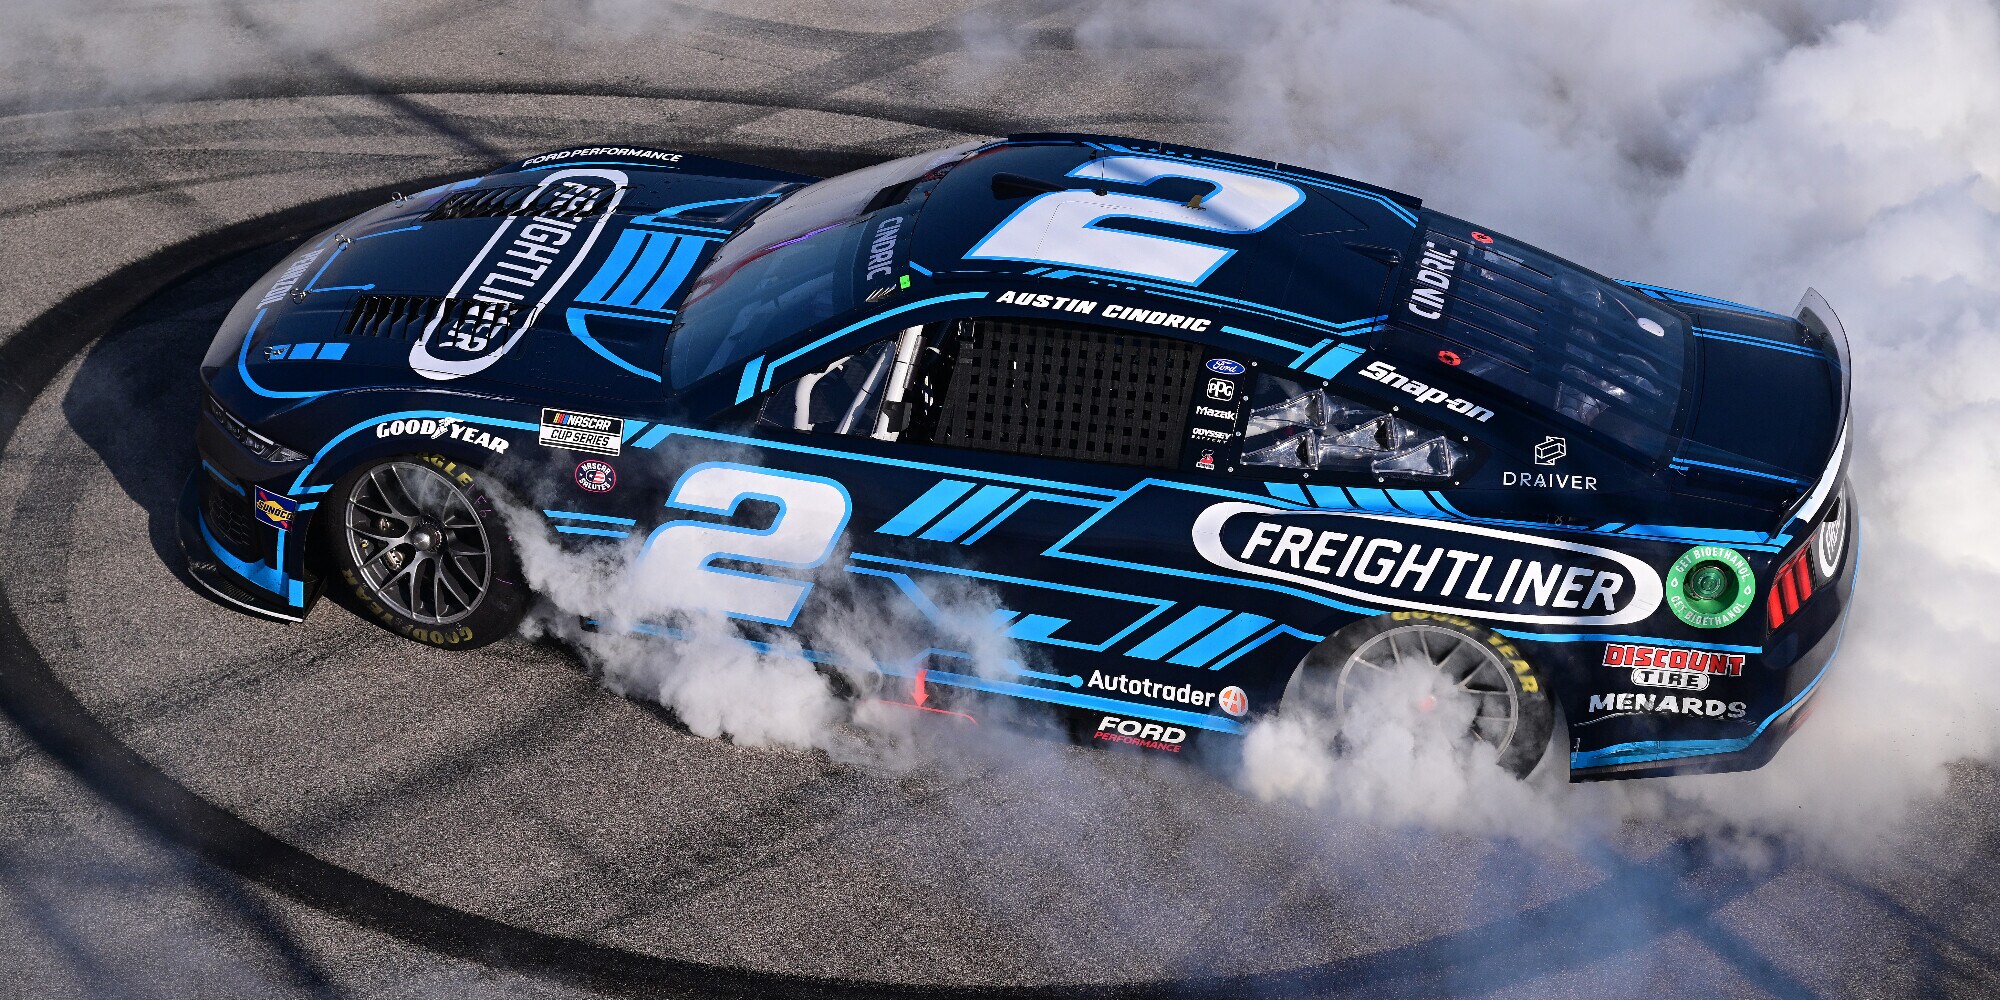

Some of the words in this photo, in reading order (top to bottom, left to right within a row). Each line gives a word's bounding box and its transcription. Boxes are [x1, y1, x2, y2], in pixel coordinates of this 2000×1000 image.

[522, 151, 571, 168] FORD
[571, 148, 683, 162] PERFORMANCE
[962, 154, 1307, 286] 2
[867, 217, 904, 281] CINDRIC
[996, 290, 1098, 315] AUSTIN
[1101, 304, 1212, 332] CINDRIC
[1209, 381, 1233, 397] PPG
[1358, 361, 1495, 423] Snap-on
[567, 415, 611, 431] NASCAR
[1196, 405, 1236, 421] Mazak
[551, 429, 577, 442] CUP
[578, 433, 610, 446] SERIES
[1192, 427, 1232, 440] ODYSSEY
[581, 462, 611, 475] NASCAR
[579, 478, 611, 491] SALUTES
[1503, 471, 1598, 491] DRAIVER
[257, 500, 294, 521] SUNOCO
[635, 461, 853, 628] 2
[1240, 520, 1624, 611] FREIGHTLINER
[1675, 555, 1692, 573] GET
[1671, 595, 1687, 613] GET
[1602, 643, 1745, 677] DISCOUNT
[1087, 669, 1216, 707] Autotrader
[1640, 670, 1700, 688] TIRE
[1588, 693, 1747, 719] MENARDS
[1097, 716, 1187, 744] FORD
[1094, 731, 1182, 753] PERFORMANCE
